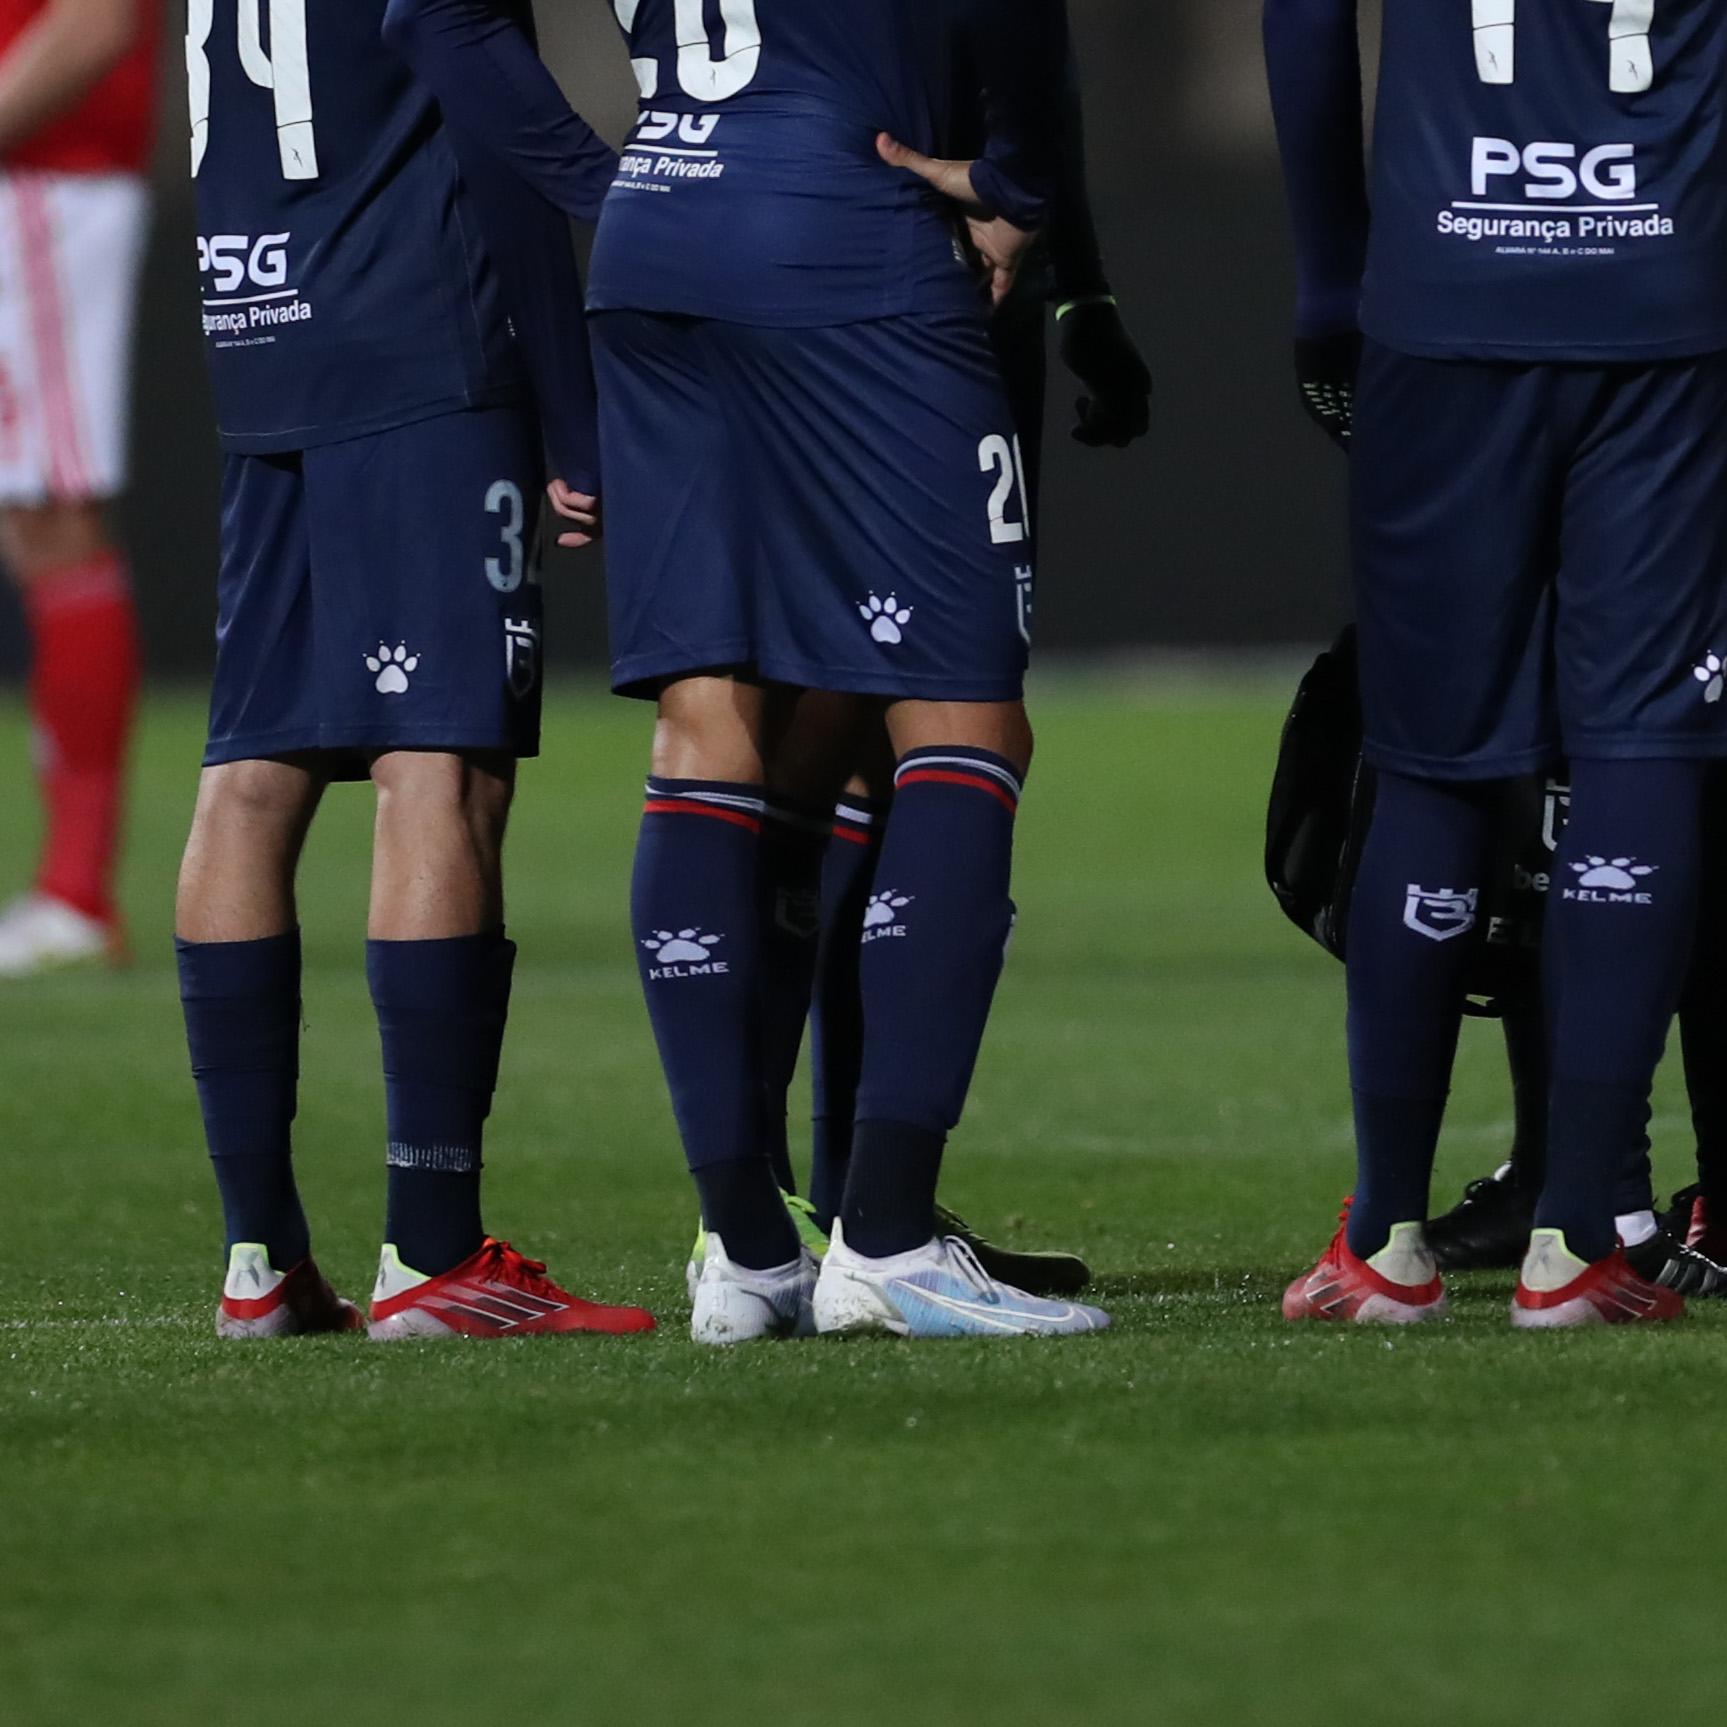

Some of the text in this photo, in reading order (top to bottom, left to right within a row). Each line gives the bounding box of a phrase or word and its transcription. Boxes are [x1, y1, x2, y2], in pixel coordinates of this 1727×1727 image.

[653, 156, 725, 178] Privada
[1471, 137, 1636, 199] PSG
[1437, 210, 1674, 243] Segurança Privada
[249, 299, 312, 327] Privada
[1562, 888, 1653, 904] KELME
[861, 925, 907, 944] ELME
[649, 961, 730, 980] KELME
